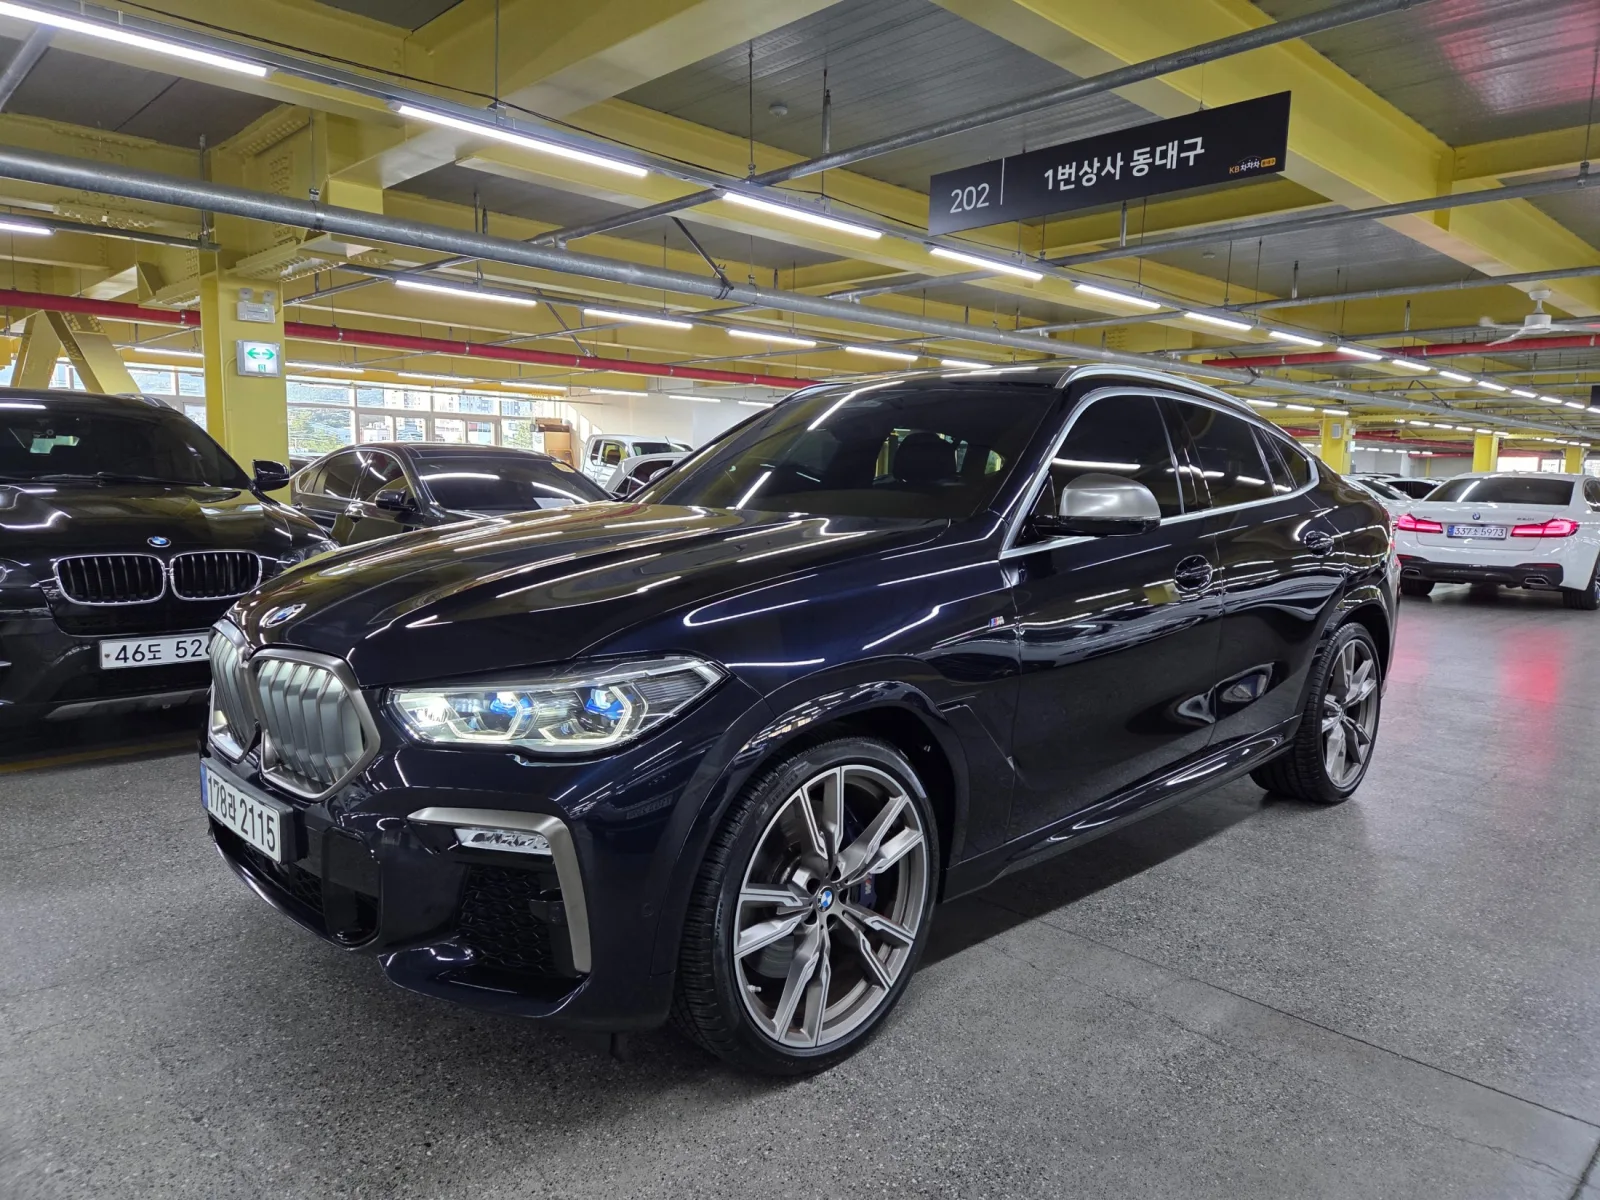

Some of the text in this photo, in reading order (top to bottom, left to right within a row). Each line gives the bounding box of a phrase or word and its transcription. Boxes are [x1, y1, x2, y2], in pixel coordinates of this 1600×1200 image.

[1044, 136, 1206, 192] 1번상사 동대구
[1229, 165, 1240, 175] KB
[949, 182, 990, 214] 202
[1480, 527, 1504, 537] 5973
[114, 643, 162, 664] 46도
[207, 775, 276, 852] 178라 2115
